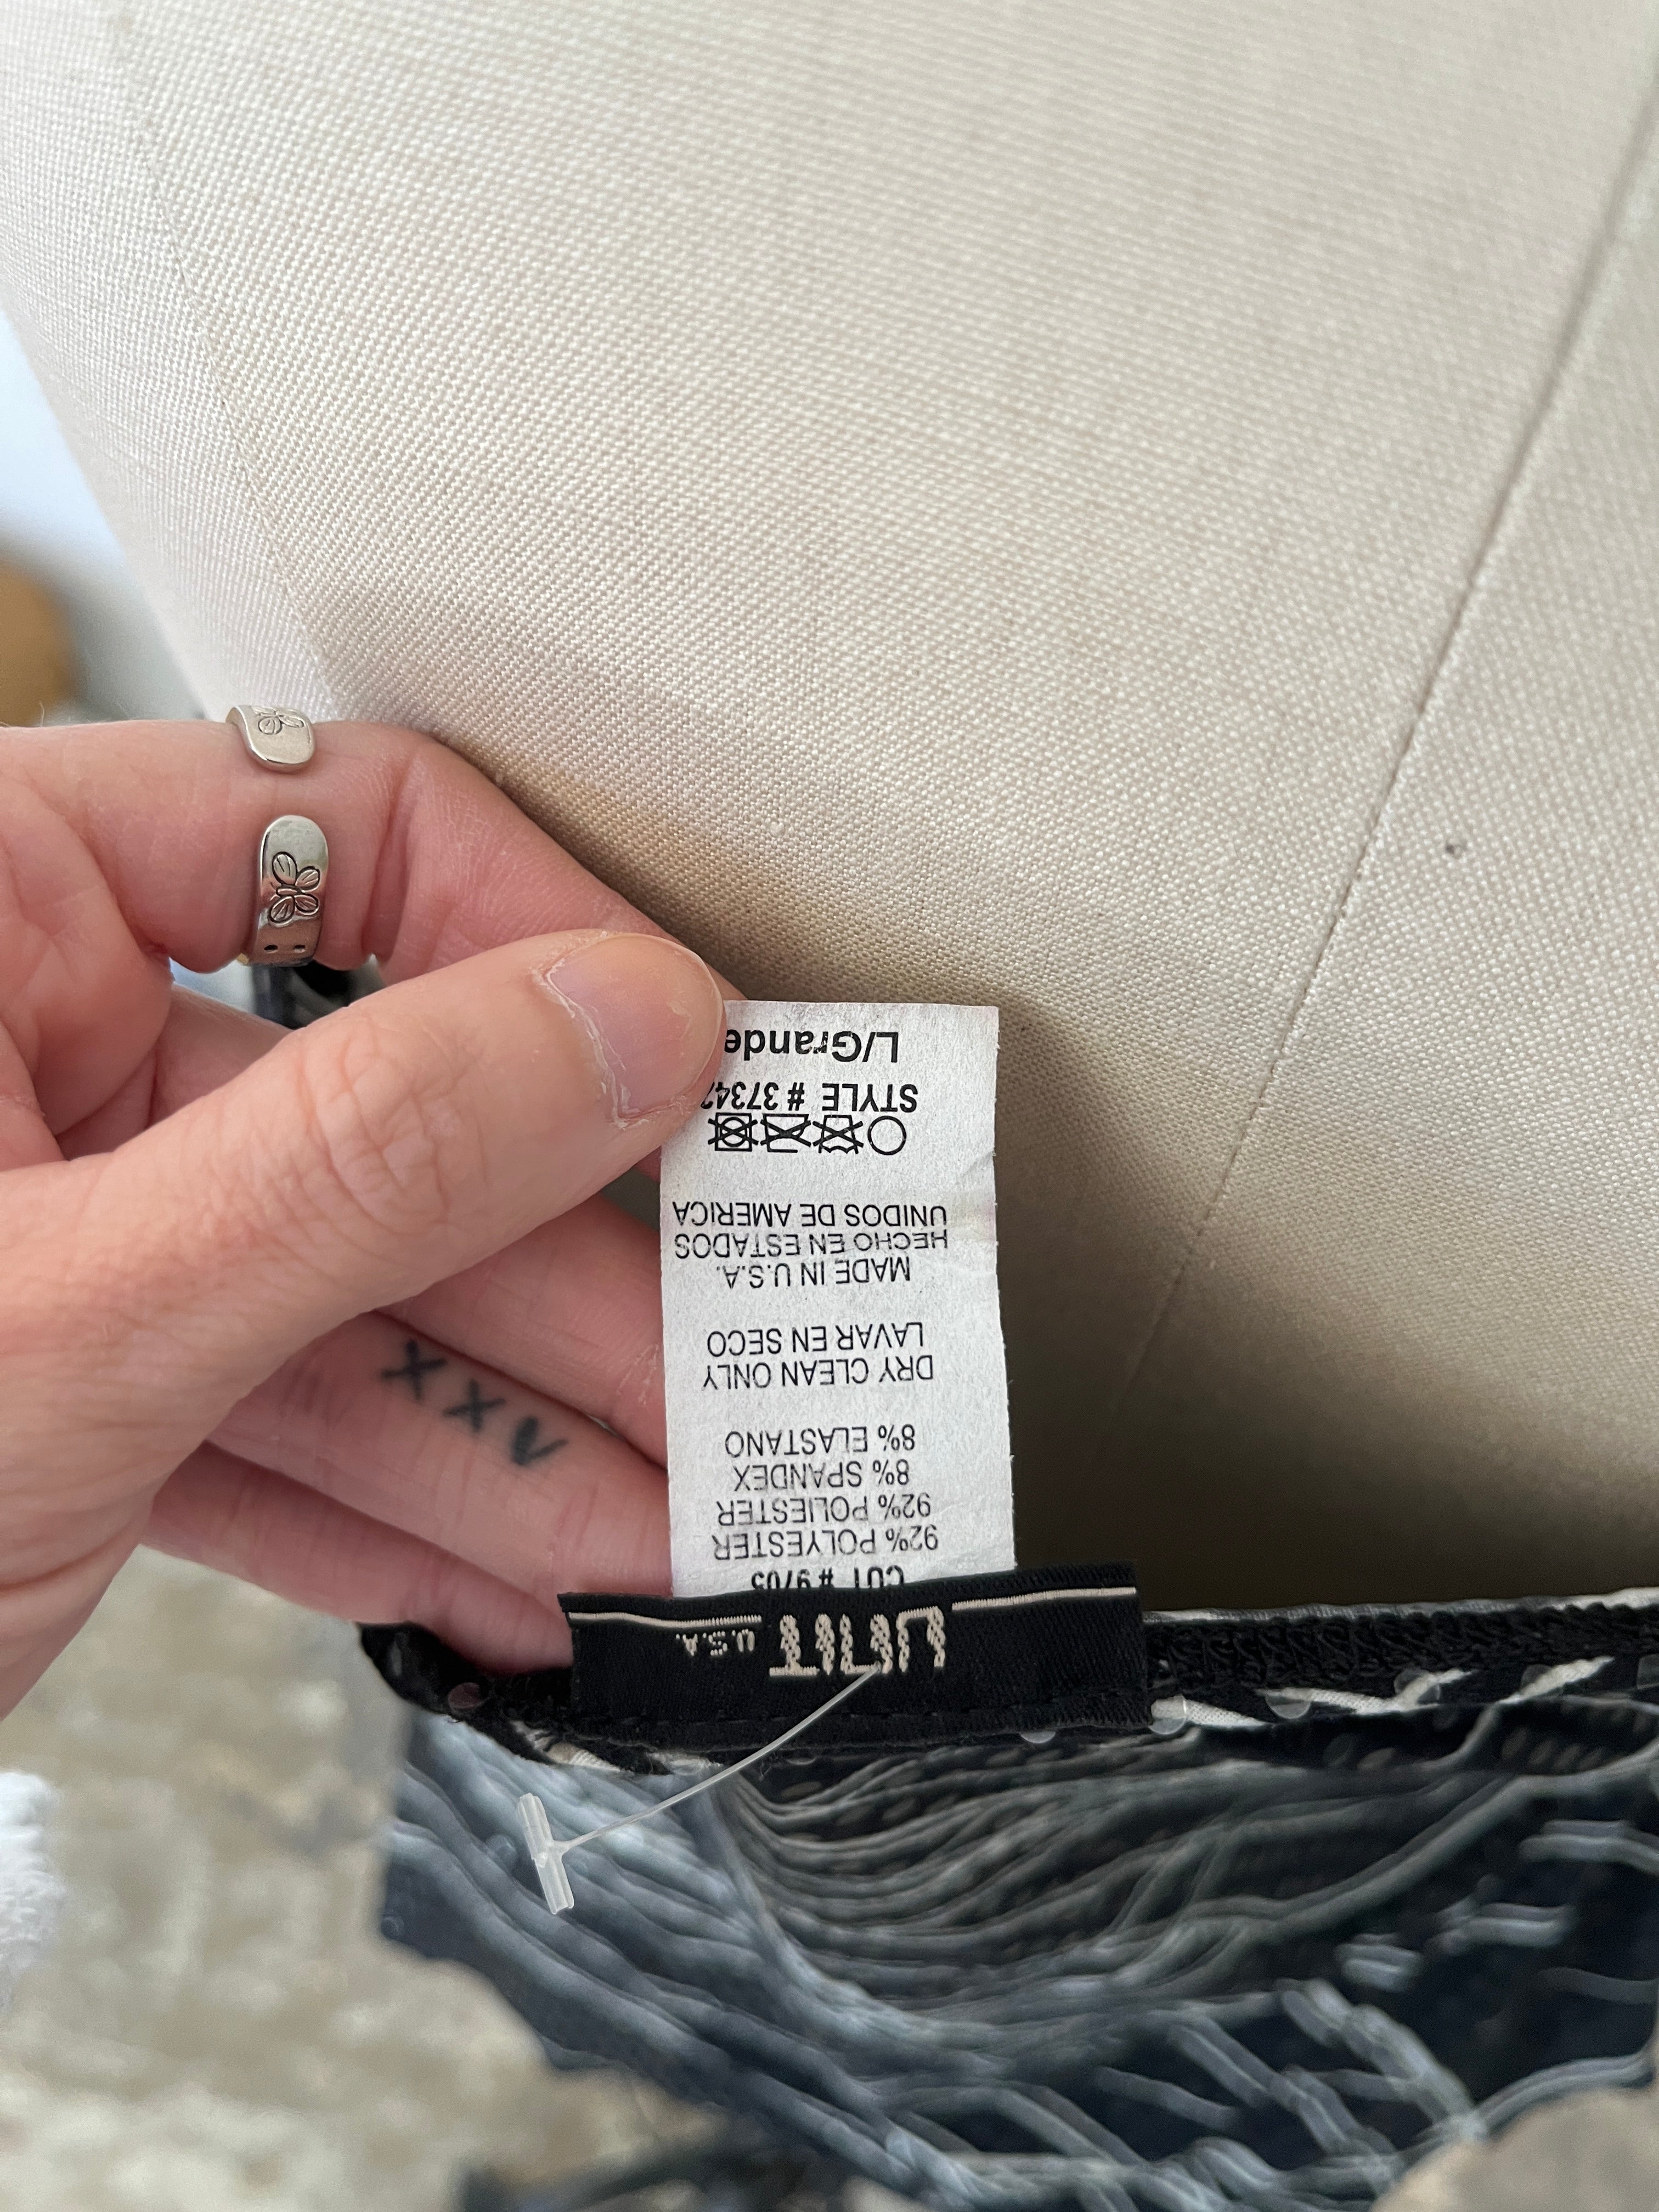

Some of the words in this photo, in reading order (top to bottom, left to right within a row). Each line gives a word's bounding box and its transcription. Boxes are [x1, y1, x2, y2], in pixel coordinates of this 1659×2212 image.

[724, 1029, 900, 1063] L/Grande
[787, 1081, 805, 1111] #
[821, 1082, 918, 1114] STYLE
[672, 1201, 792, 1228] AMERICA
[799, 1203, 836, 1227] DE
[843, 1203, 947, 1227] UNIDOS
[674, 1233, 802, 1260] ESTADOS
[809, 1233, 847, 1256] EN
[853, 1228, 948, 1252] HECHO
[716, 1262, 792, 1289] U.S.A.
[800, 1260, 825, 1286] IN
[834, 1256, 911, 1285] MADE
[707, 1328, 782, 1358] SECO
[792, 1325, 827, 1353] EN
[834, 1322, 924, 1351] LAVAR
[703, 1362, 772, 1390] ONLY
[781, 1357, 870, 1387] CLEAN
[878, 1354, 934, 1383] DRY
[725, 1426, 868, 1459] ELASTANO
[877, 1424, 916, 1452] 8%
[733, 1460, 862, 1492] SPANDEX
[872, 1458, 910, 1486] 8%
[716, 1496, 869, 1527] POLIESTER
[878, 1492, 931, 1521] 92%
[711, 1528, 876, 1561] POLYESTER
[885, 1524, 939, 1553] 92%
[675, 1628, 755, 1657] U.S.A.
